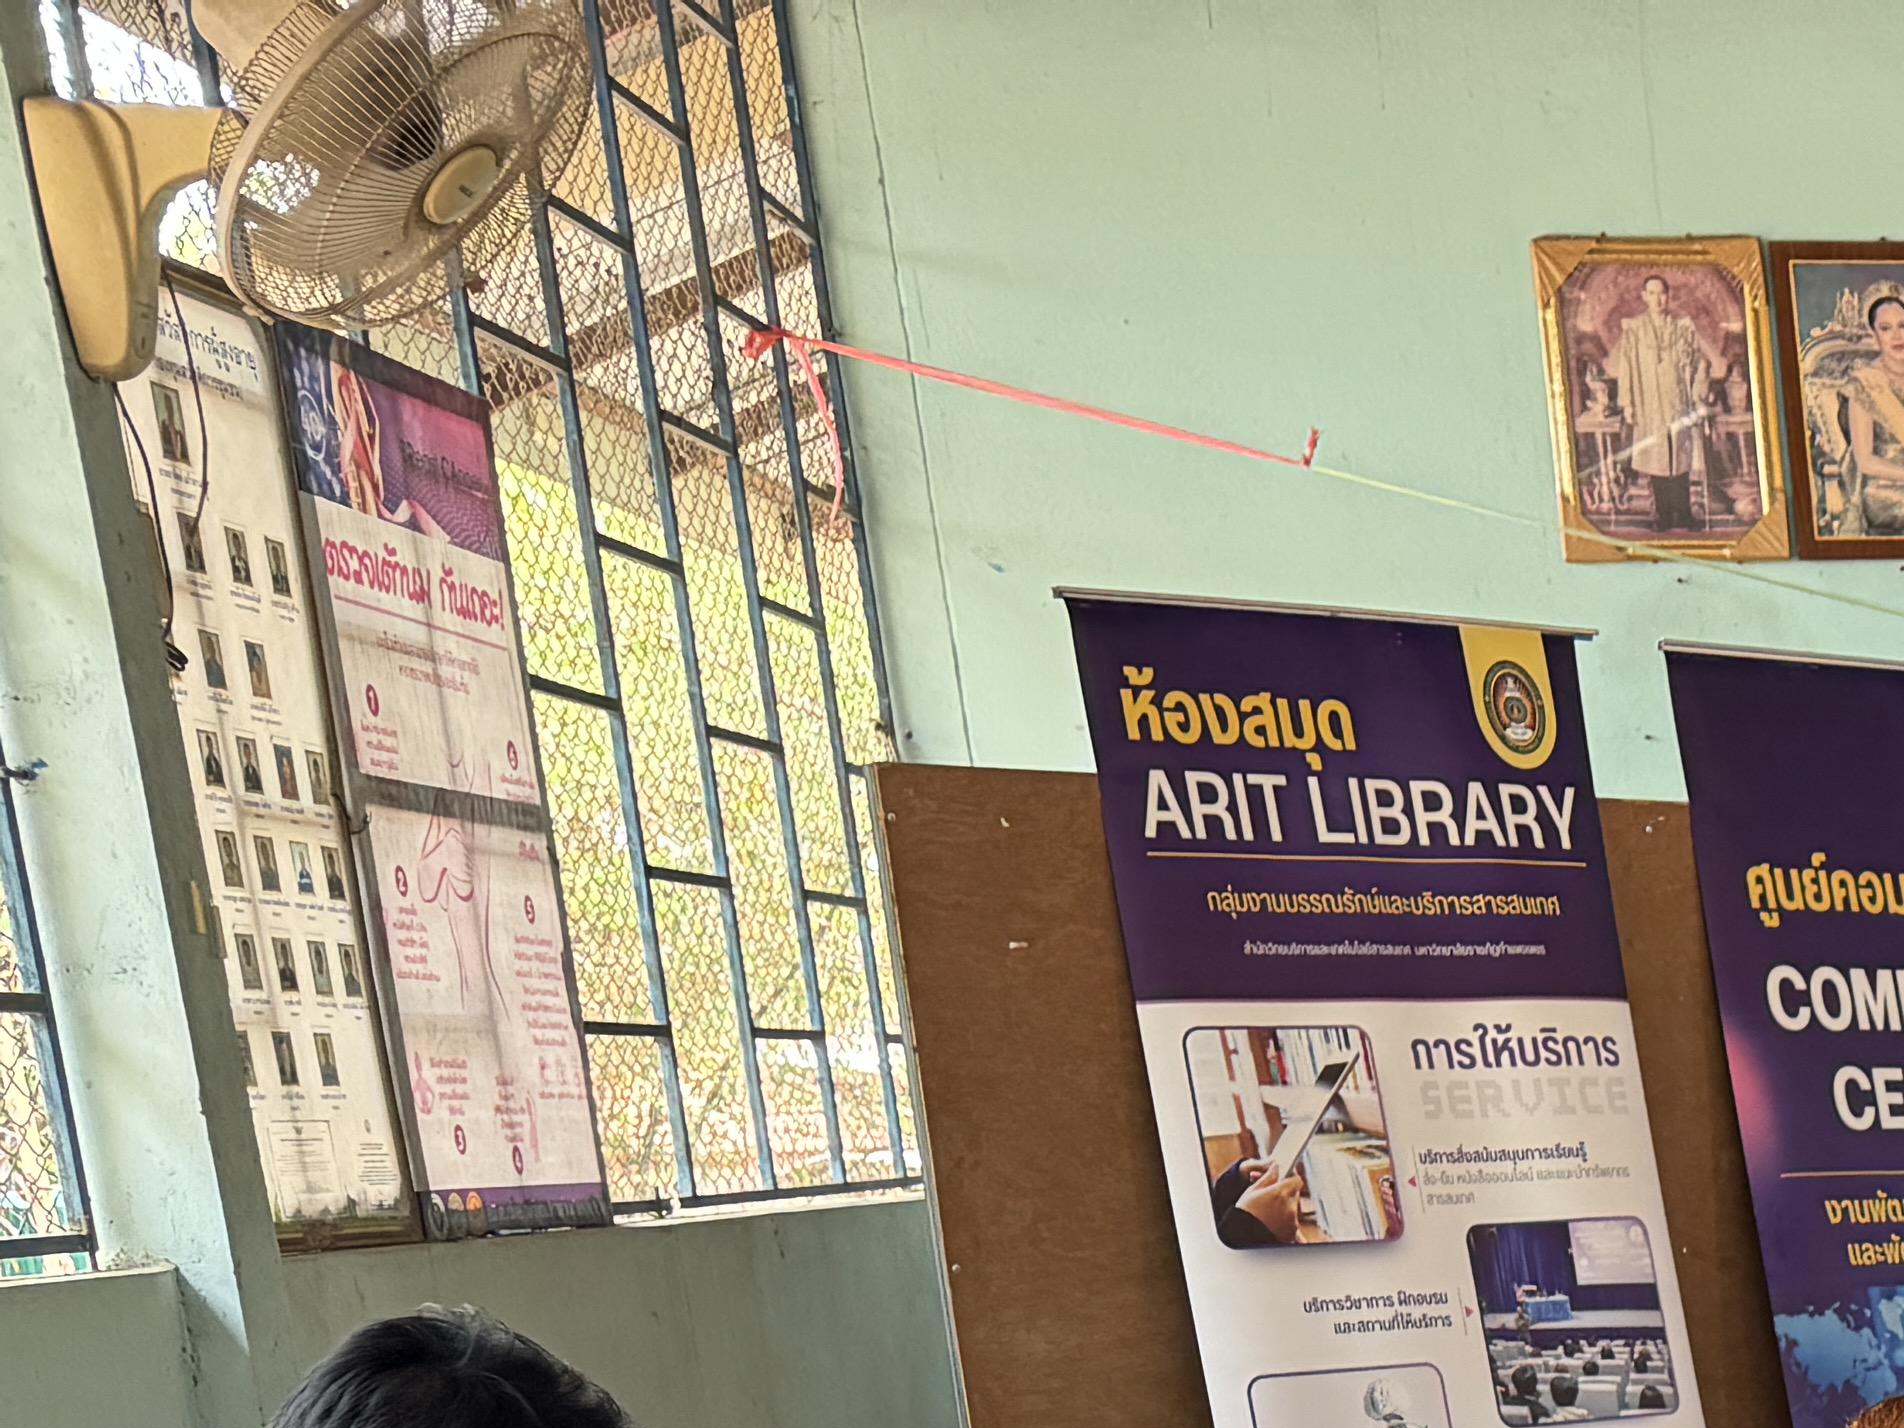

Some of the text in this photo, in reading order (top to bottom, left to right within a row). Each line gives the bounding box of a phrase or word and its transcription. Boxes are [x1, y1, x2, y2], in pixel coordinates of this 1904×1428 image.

[1121, 666, 1357, 770] ห้องสมุด
[1144, 768, 1577, 851] ARIT LIBRARY
[1410, 1023, 1621, 1072] การให้บริการ
[1420, 1075, 1631, 1120] SERVICE
